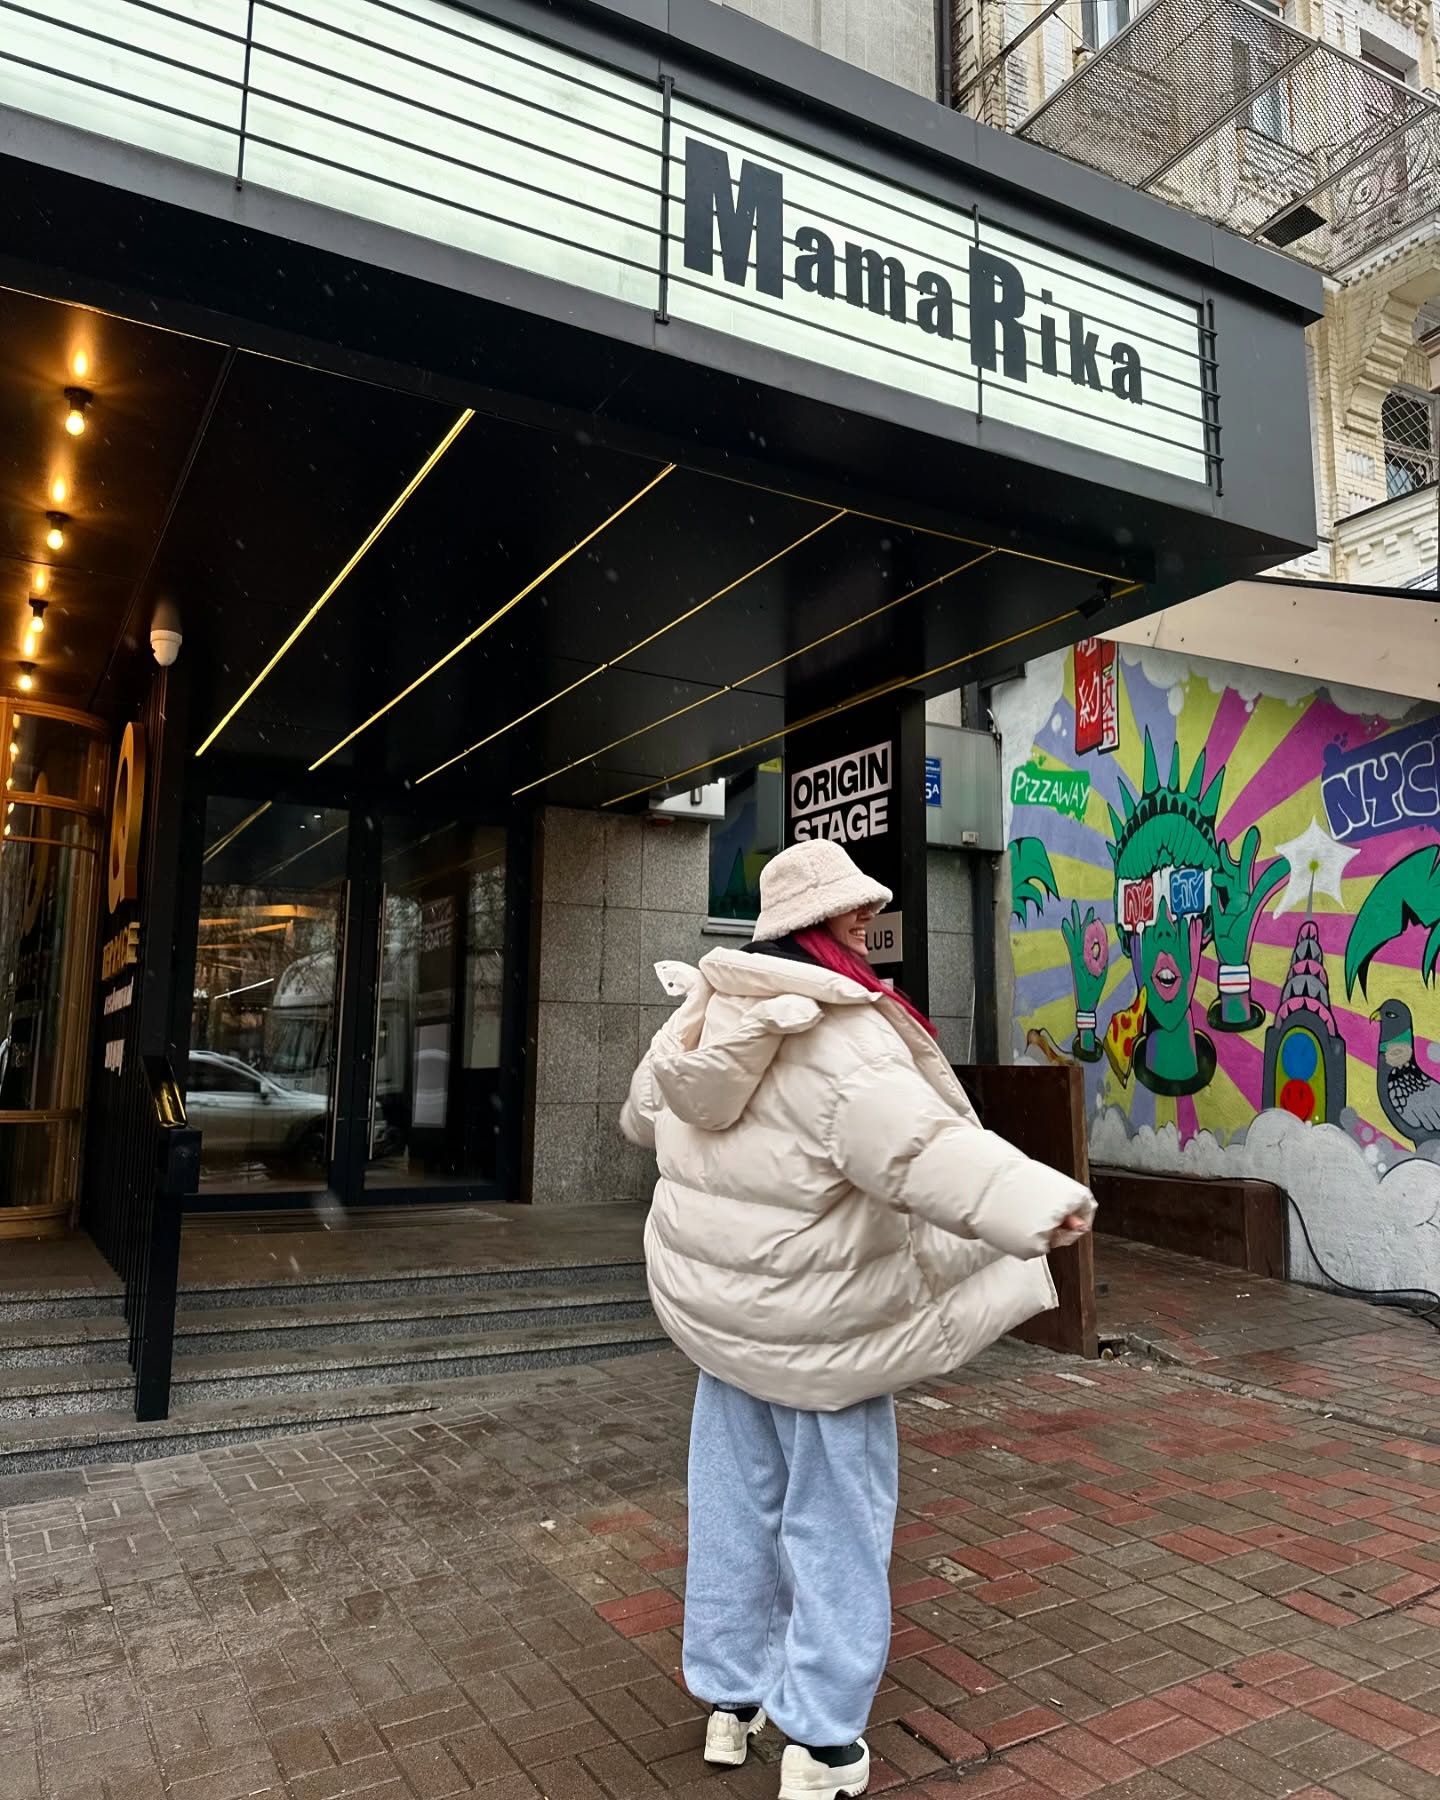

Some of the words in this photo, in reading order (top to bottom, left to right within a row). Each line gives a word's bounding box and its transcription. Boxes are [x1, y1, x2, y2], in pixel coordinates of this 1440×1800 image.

[684, 136, 1143, 405] MamaRika
[793, 747, 889, 811] ORIGIN
[794, 796, 889, 844] STAGE
[865, 929, 894, 951] LUB
